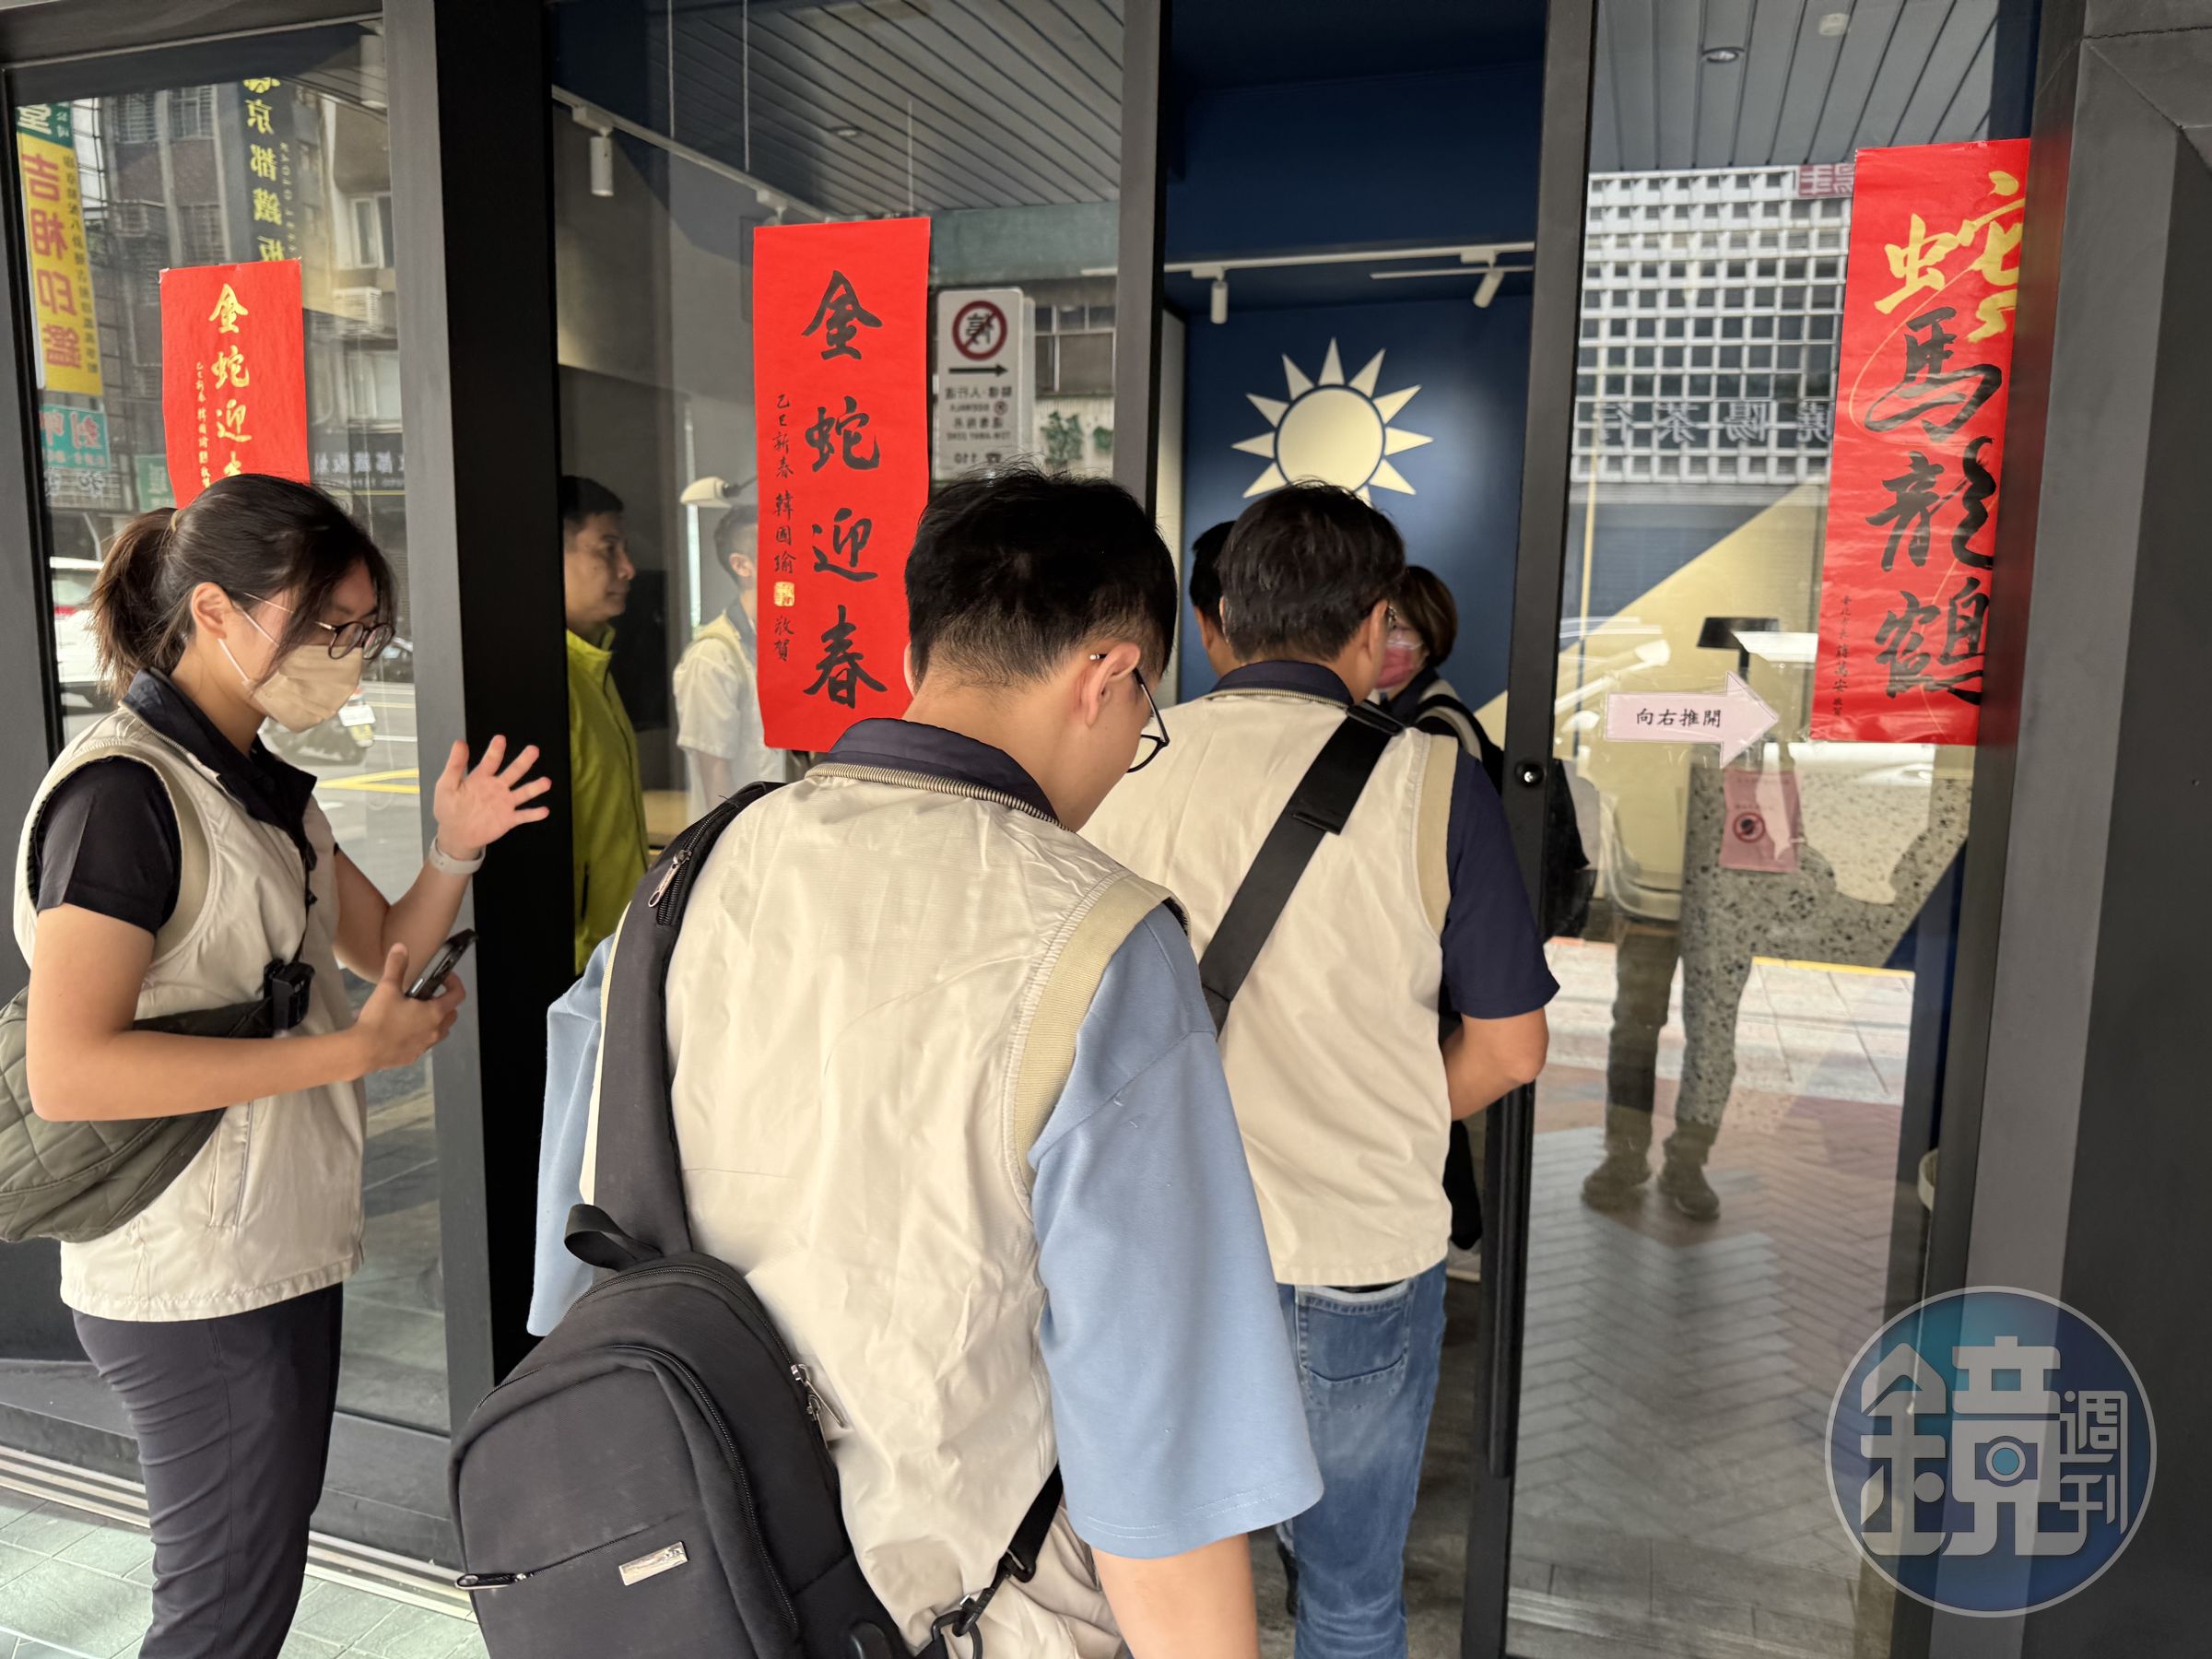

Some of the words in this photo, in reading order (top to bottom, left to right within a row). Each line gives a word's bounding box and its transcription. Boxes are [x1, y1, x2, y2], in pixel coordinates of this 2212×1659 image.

[801, 269, 888, 710] 金蛇迎春
[773, 492, 796, 574] 韓國瑜
[1636, 708, 1722, 727] 向右推開
